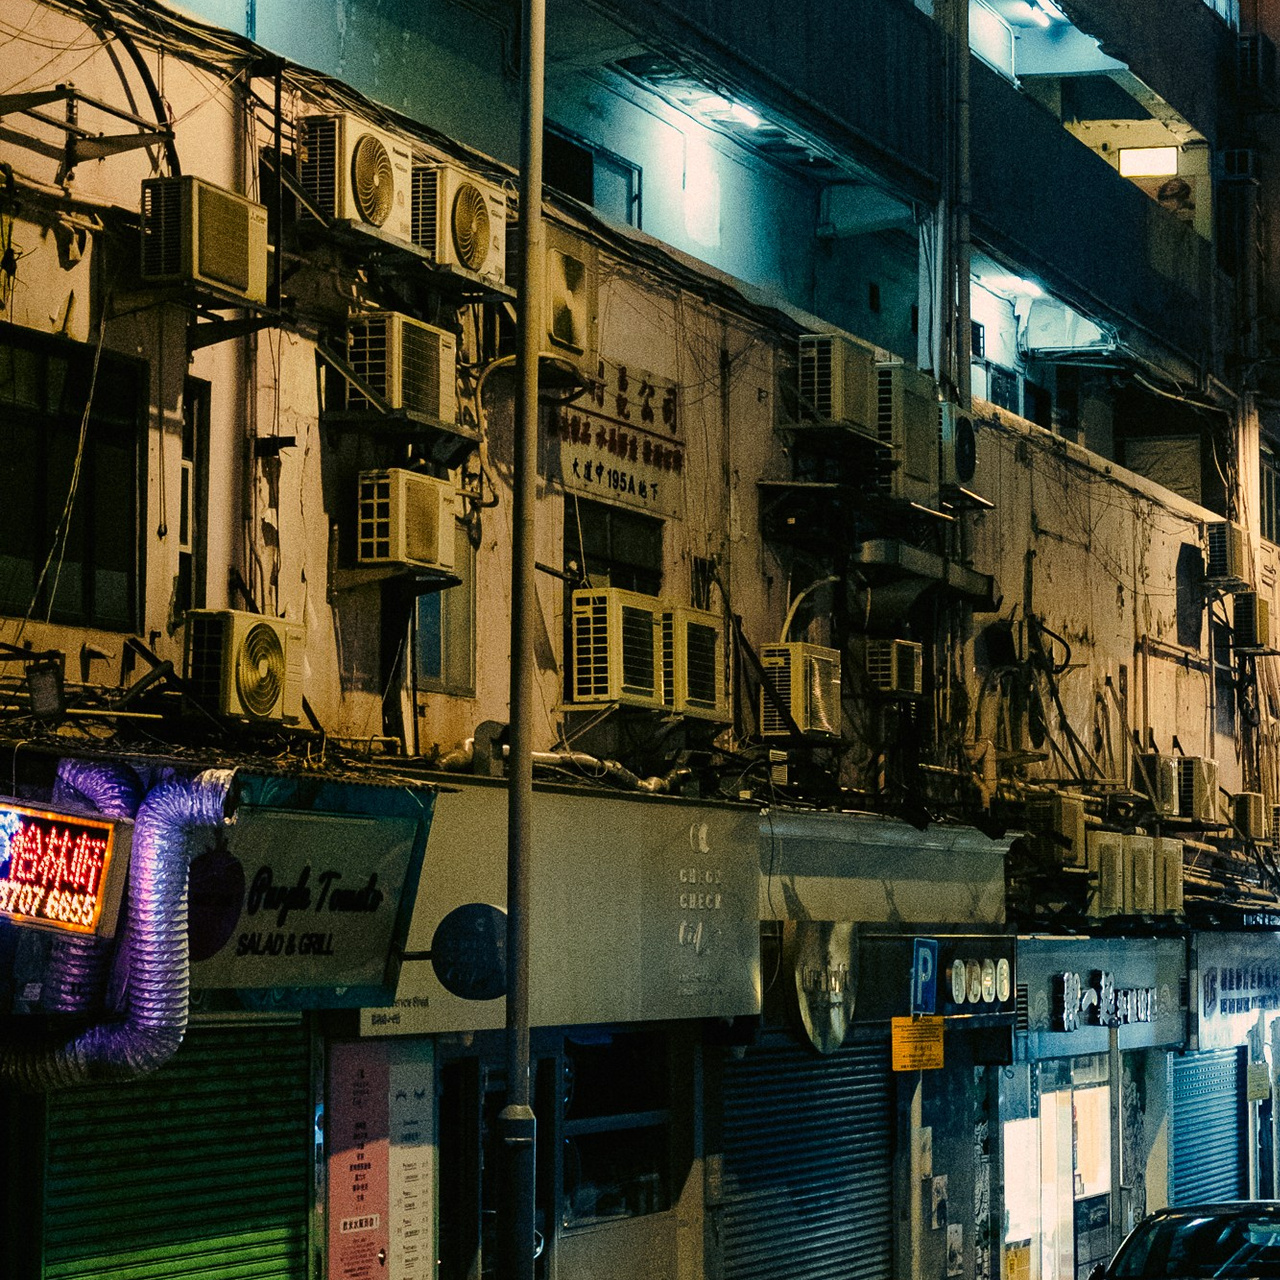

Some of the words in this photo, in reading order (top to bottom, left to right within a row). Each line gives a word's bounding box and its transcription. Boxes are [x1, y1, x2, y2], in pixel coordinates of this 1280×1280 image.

[315, 870, 384, 913] Tomato
[236, 933, 284, 956] SALAD
[298, 933, 335, 956] GRILL
[916, 947, 933, 1005] P
